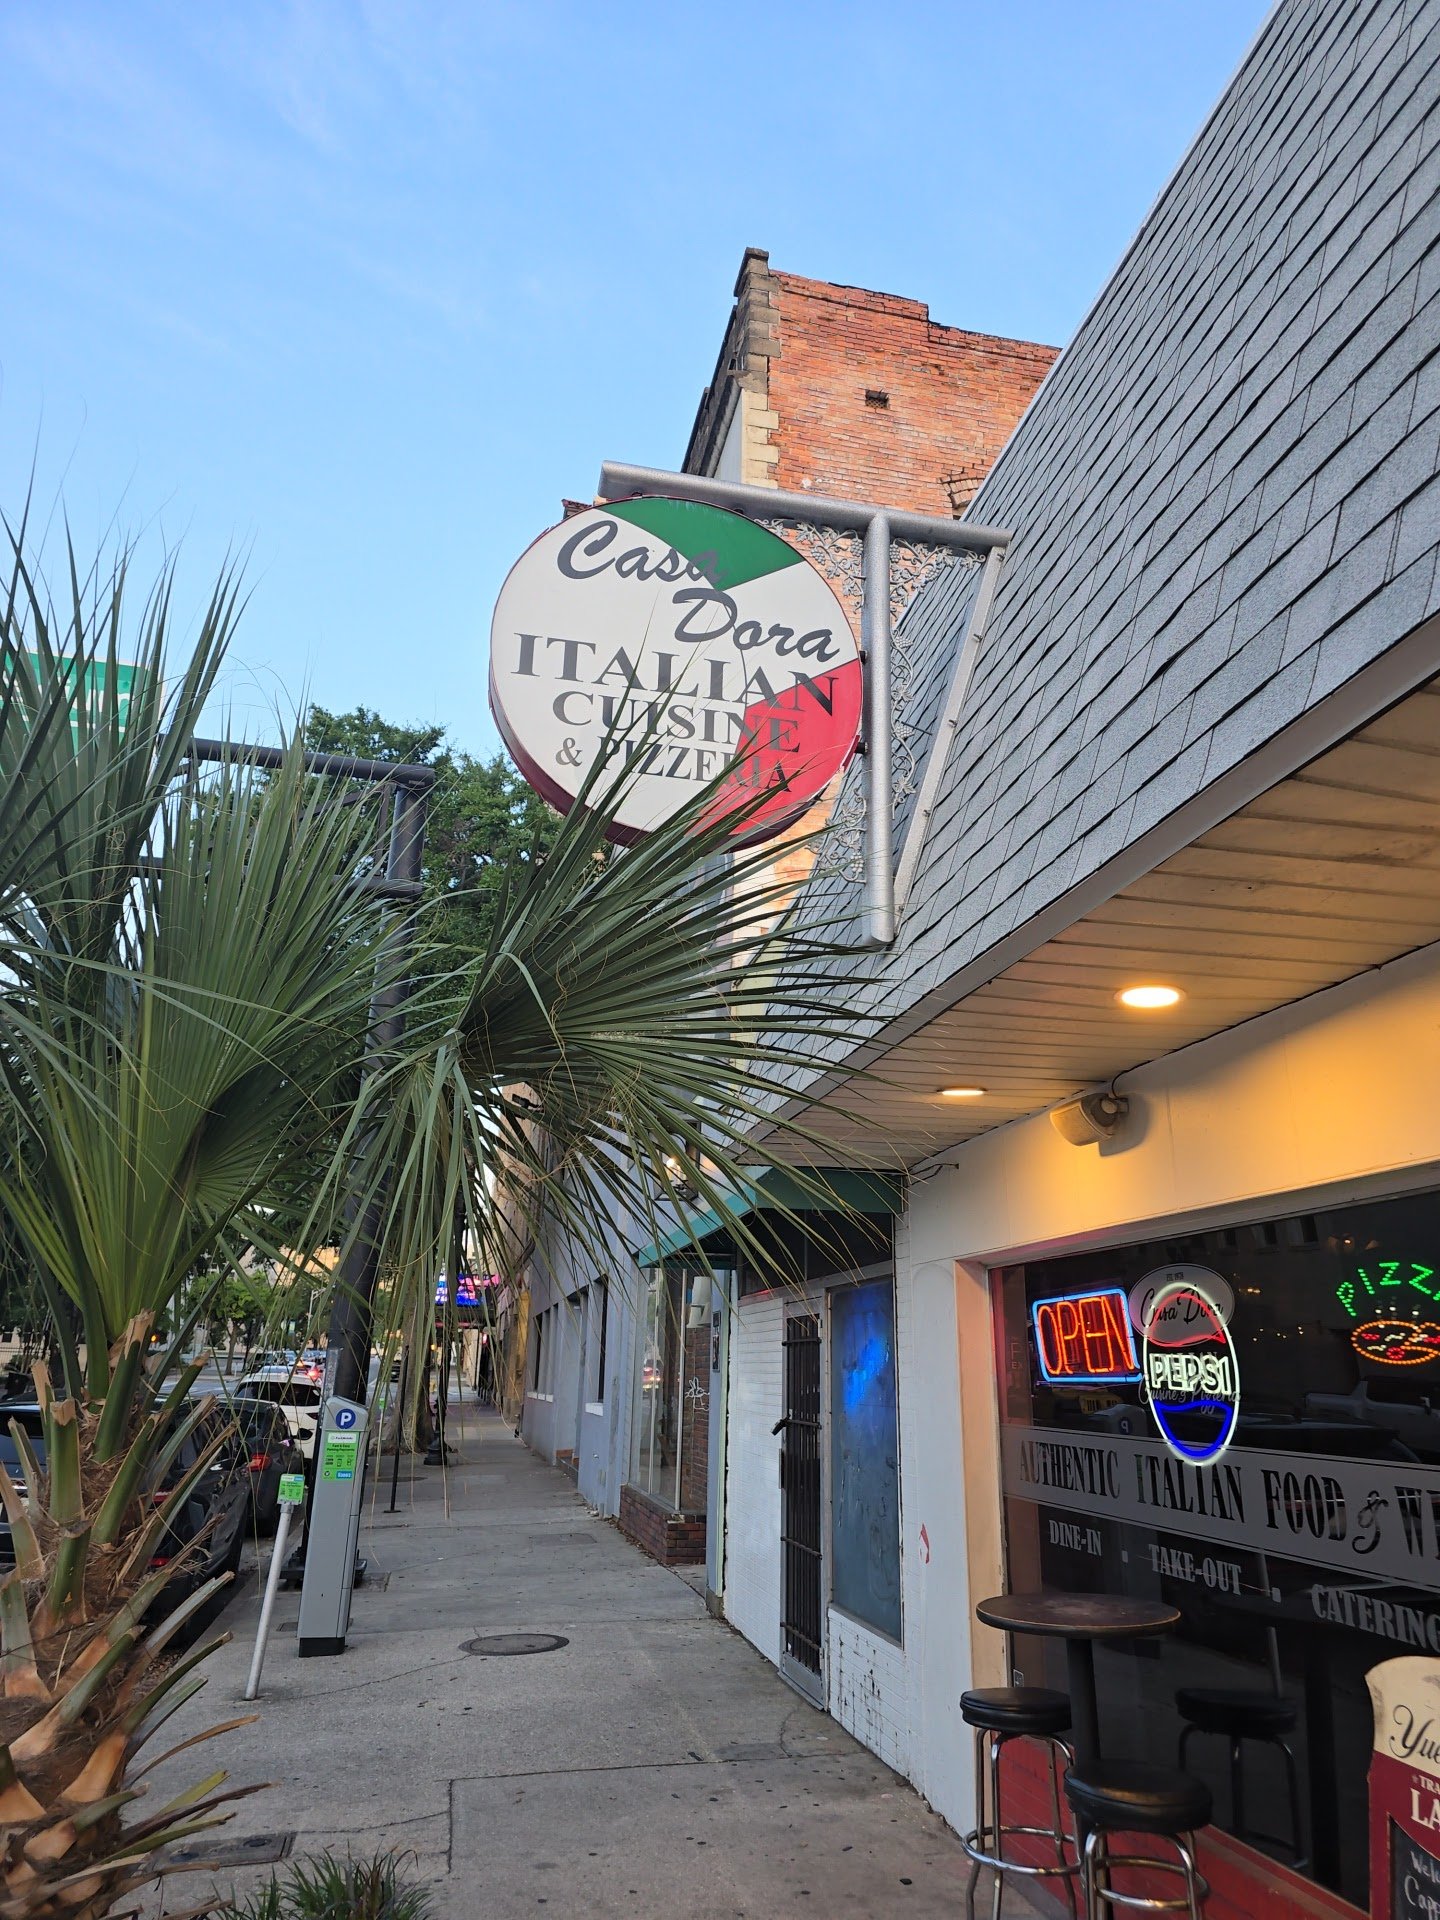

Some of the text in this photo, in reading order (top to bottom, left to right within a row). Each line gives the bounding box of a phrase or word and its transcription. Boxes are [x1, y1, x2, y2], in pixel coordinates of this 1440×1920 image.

[557, 520, 728, 583] Casa
[672, 587, 840, 662] Dora
[511, 632, 839, 717] ITALIAN
[552, 691, 801, 753] CUISINE
[555, 737, 583, 767] &
[1336, 1261, 1440, 1316] PIZZ
[1037, 1295, 1137, 1375] OPEN
[1149, 1353, 1232, 1396] PEPSI
[1020, 1440, 1120, 1499] AUTHENTIC
[1134, 1453, 1246, 1523] ITALIAN
[1261, 1469, 1347, 1541] FOOD
[1049, 1520, 1440, 1654] DINE-IN TAKE-OUT CATERING
